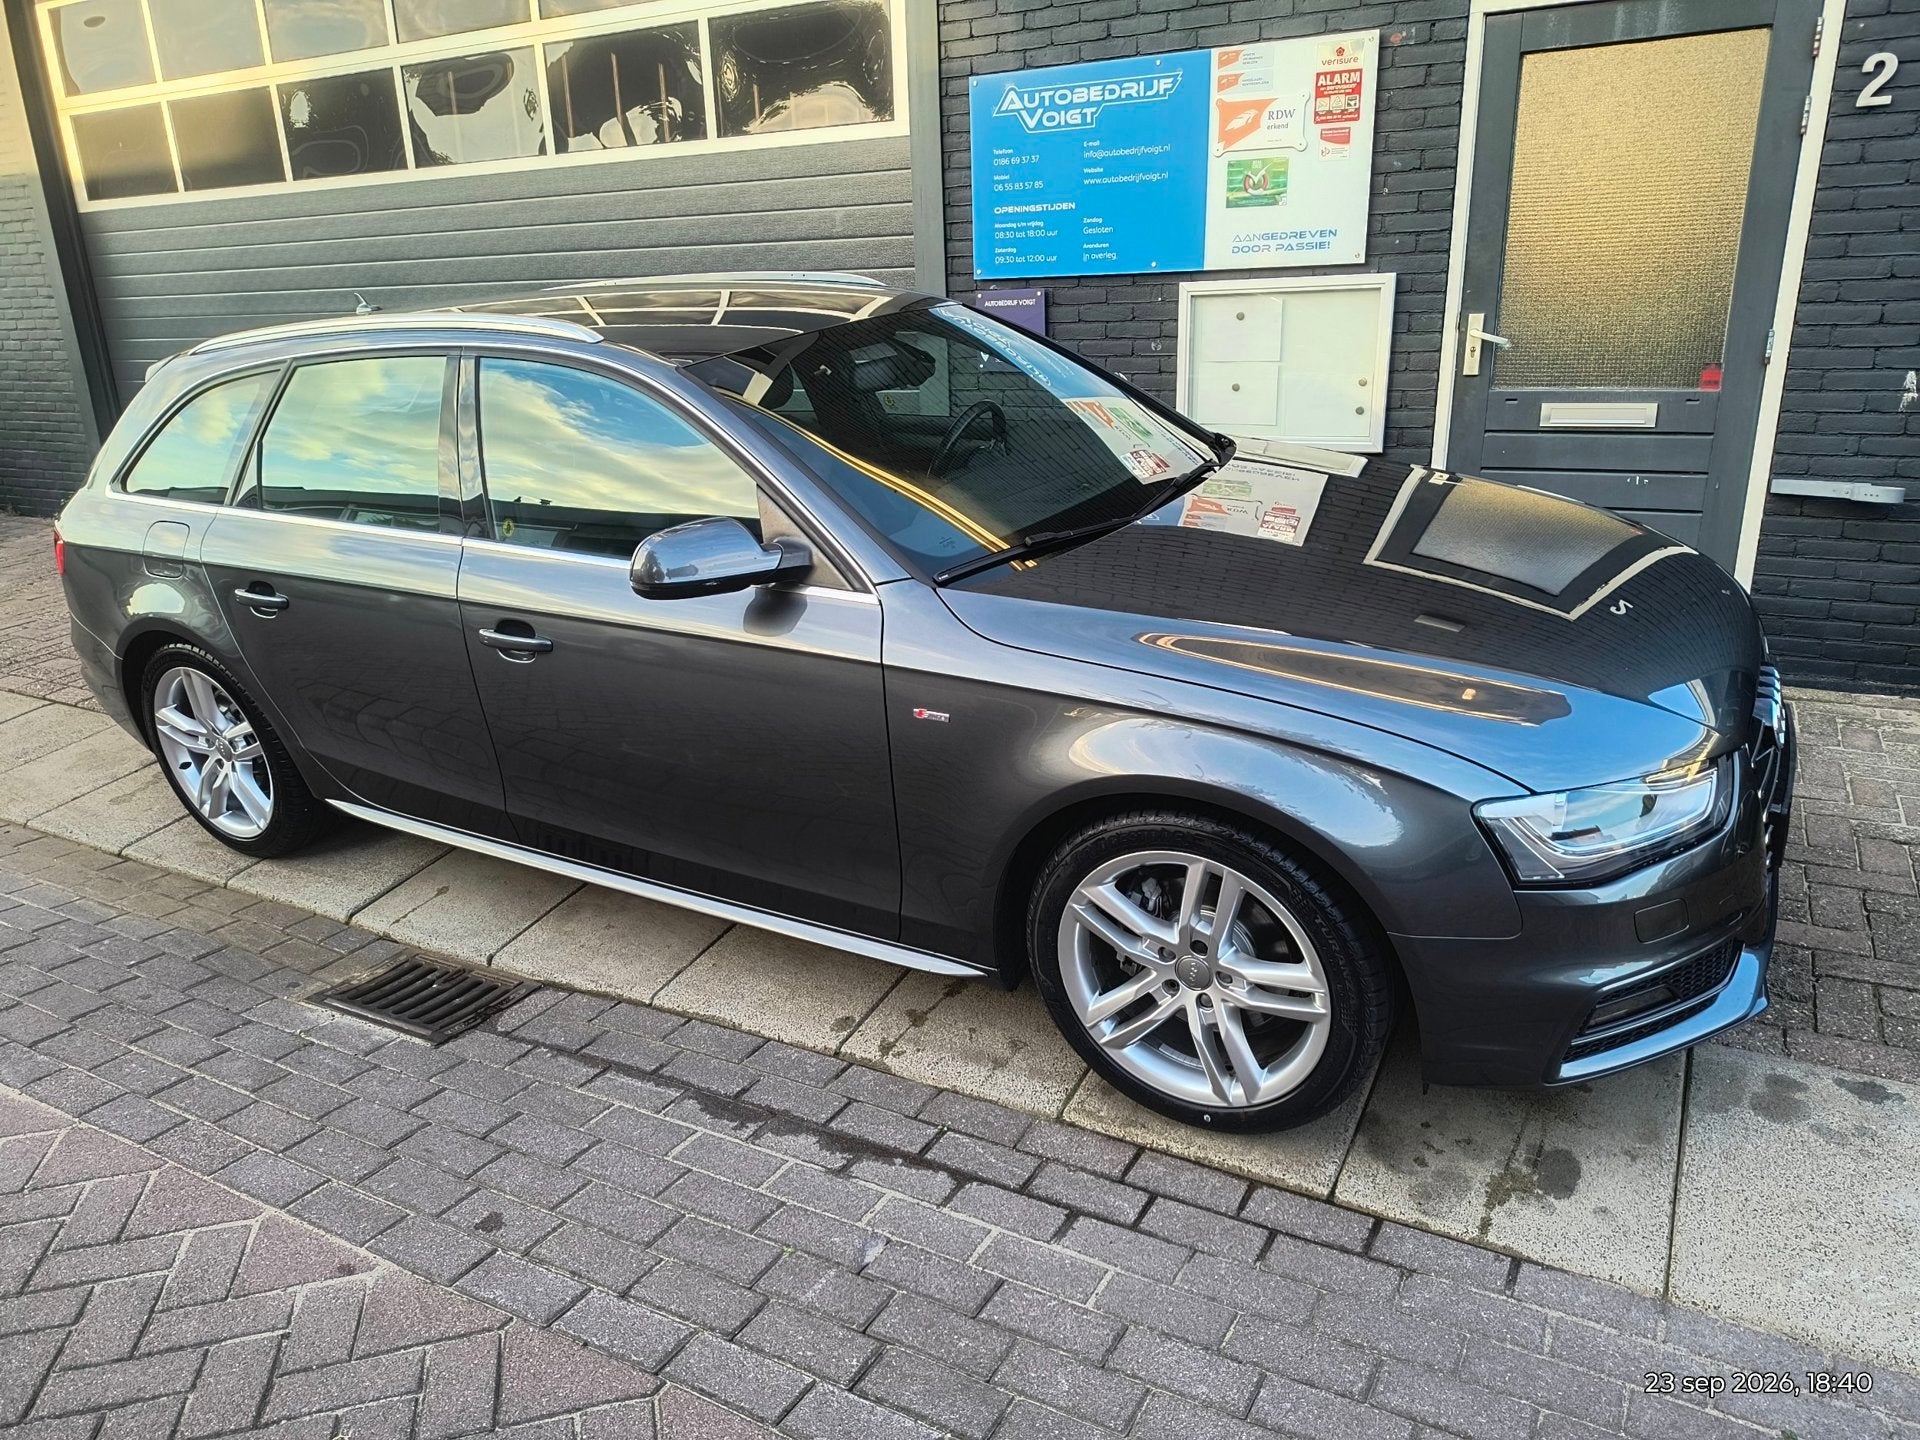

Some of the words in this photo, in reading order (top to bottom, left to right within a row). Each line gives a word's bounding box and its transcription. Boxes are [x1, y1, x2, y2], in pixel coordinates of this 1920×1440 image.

[1321, 56, 1359, 66] verisure
[1317, 71, 1360, 87] ALARM
[1856, 52, 1898, 107] 2
[1001, 78, 1174, 111] AUTOBEDRIJF
[1018, 107, 1097, 128] VOIGT
[1268, 109, 1296, 120] RDW
[1267, 122, 1288, 130] erkend
[1083, 144, 1171, 159] info@autobedrijfvoigt.nl
[1011, 156, 1020, 165] 69
[1021, 155, 1029, 164] 37
[1031, 155, 1039, 163] 37
[1083, 172, 1169, 184] www.autobedrijfvoigt.nl
[1025, 181, 1033, 189] 57
[994, 202, 1076, 214] OPENINGSTIJDEN
[995, 231, 1014, 239] 08:30
[1027, 229, 1045, 237] 18:00
[1083, 226, 1113, 234] Gesloten
[1232, 229, 1337, 243] AANGEDREVEN
[1232, 244, 1271, 254] DOOR
[1276, 241, 1331, 252] PASSIE!
[995, 256, 1014, 264] 09:30
[1091, 251, 1116, 260] overleg
